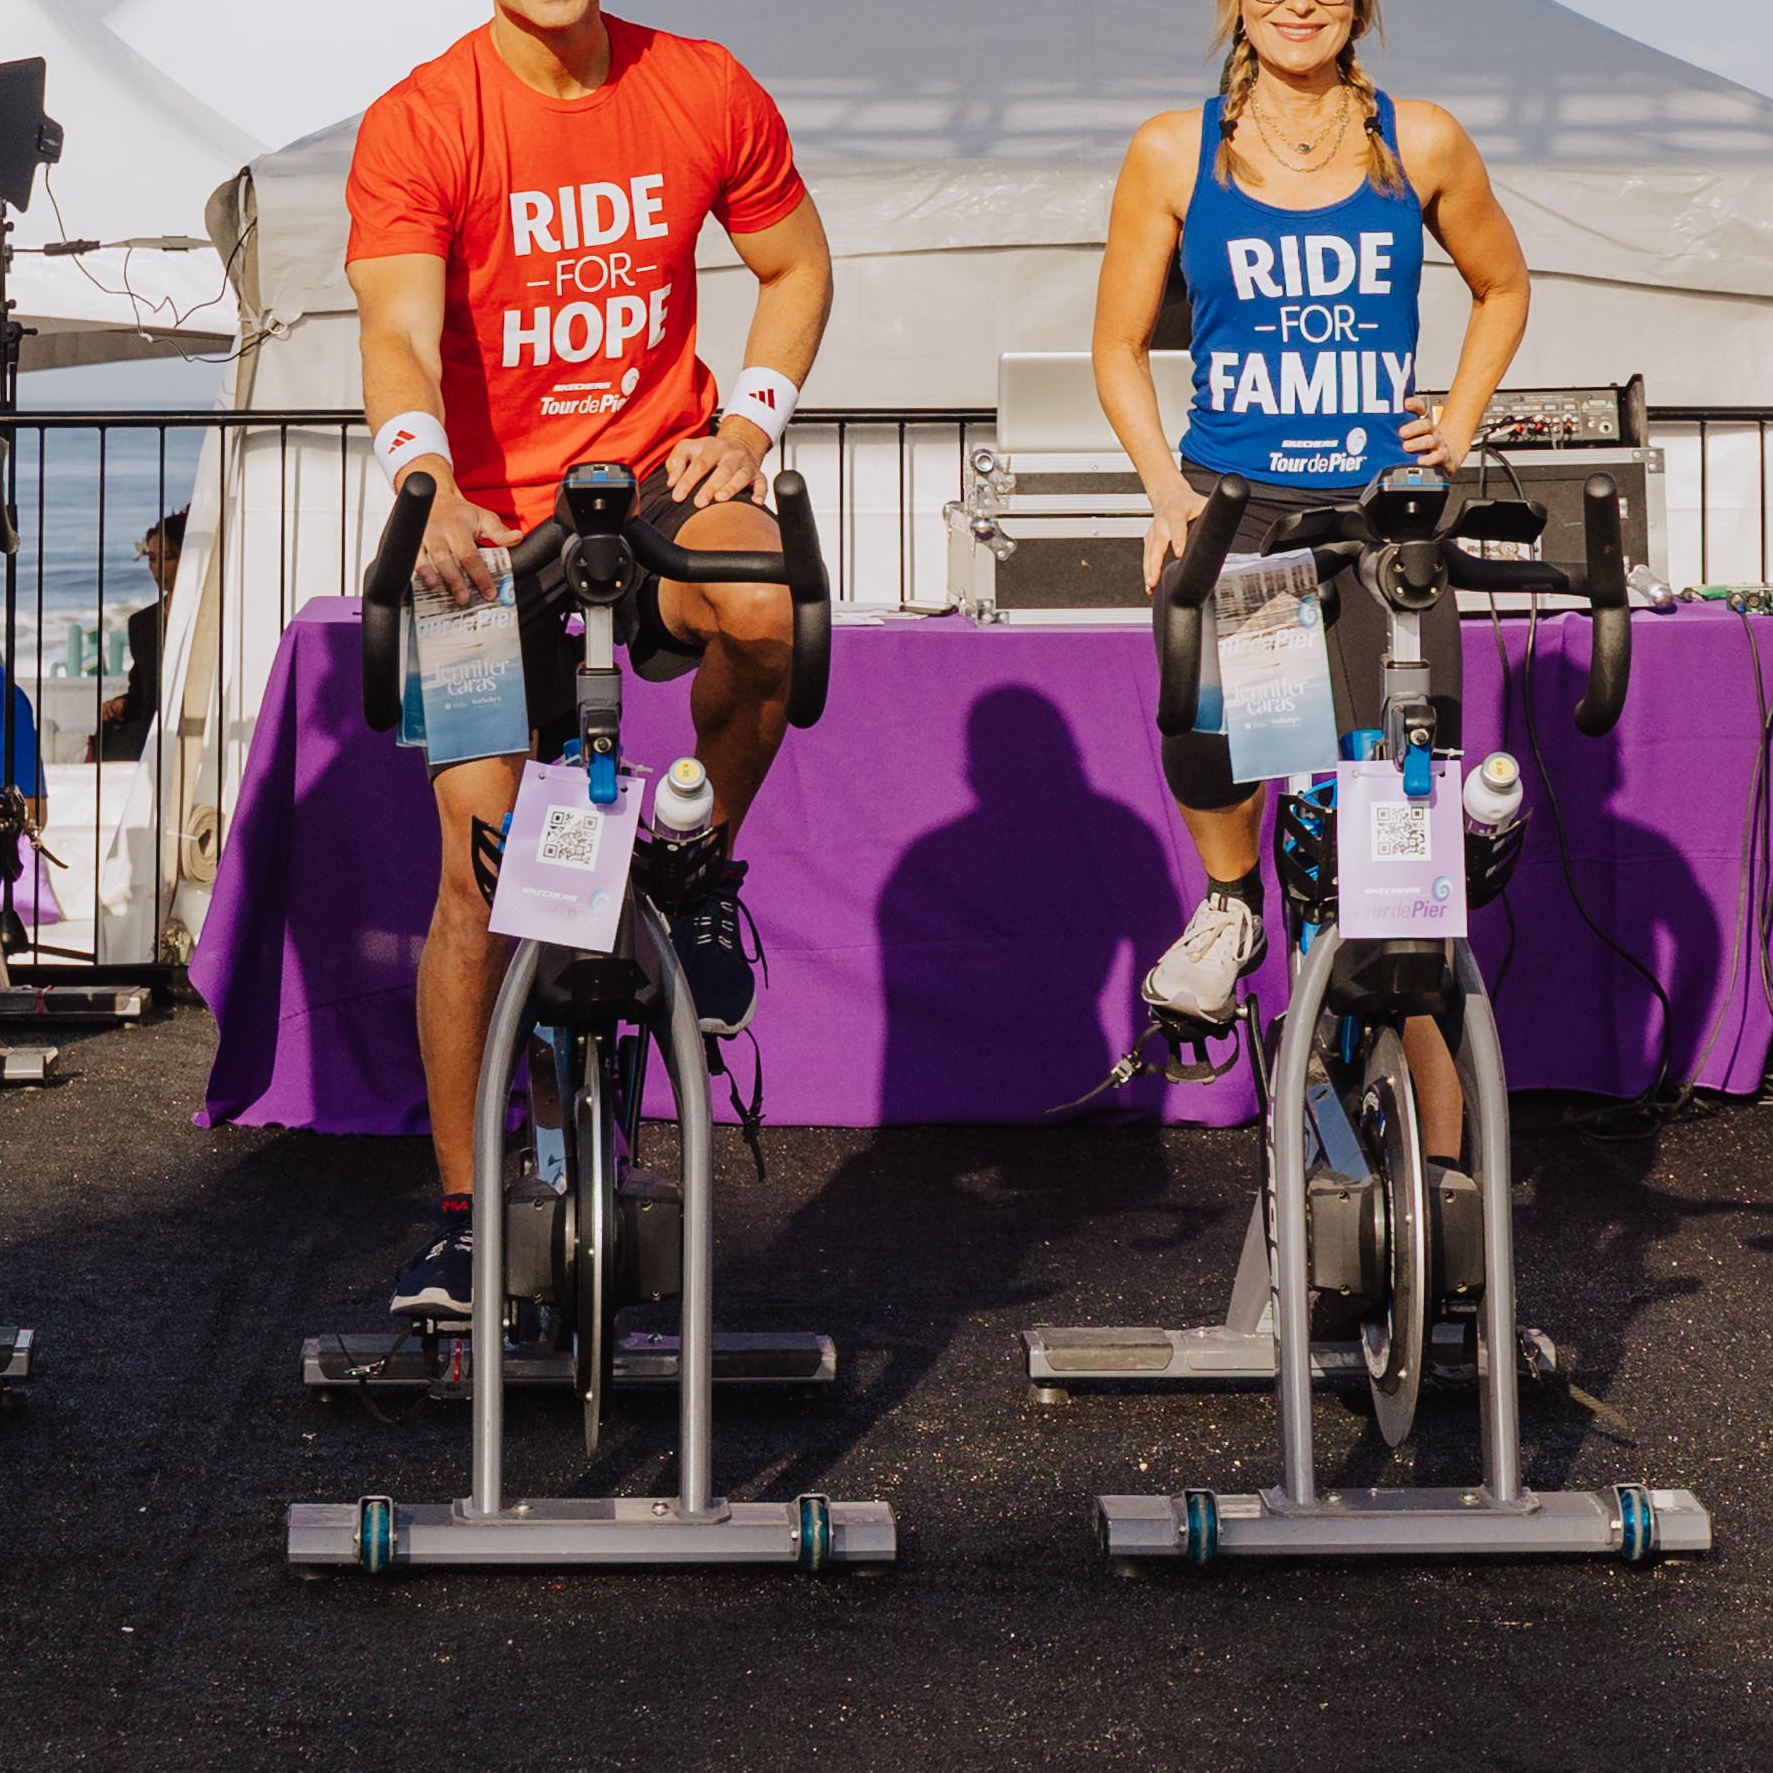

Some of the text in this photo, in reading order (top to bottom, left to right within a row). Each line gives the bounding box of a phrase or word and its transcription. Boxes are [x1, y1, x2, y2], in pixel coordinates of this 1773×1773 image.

[509, 173, 669, 256] RIDE
[555, 252, 636, 296] FOR
[1227, 231, 1394, 301] RIDE
[502, 283, 673, 368] HOPE
[1280, 304, 1359, 343] FOR
[1209, 351, 1413, 415] FAMILY
